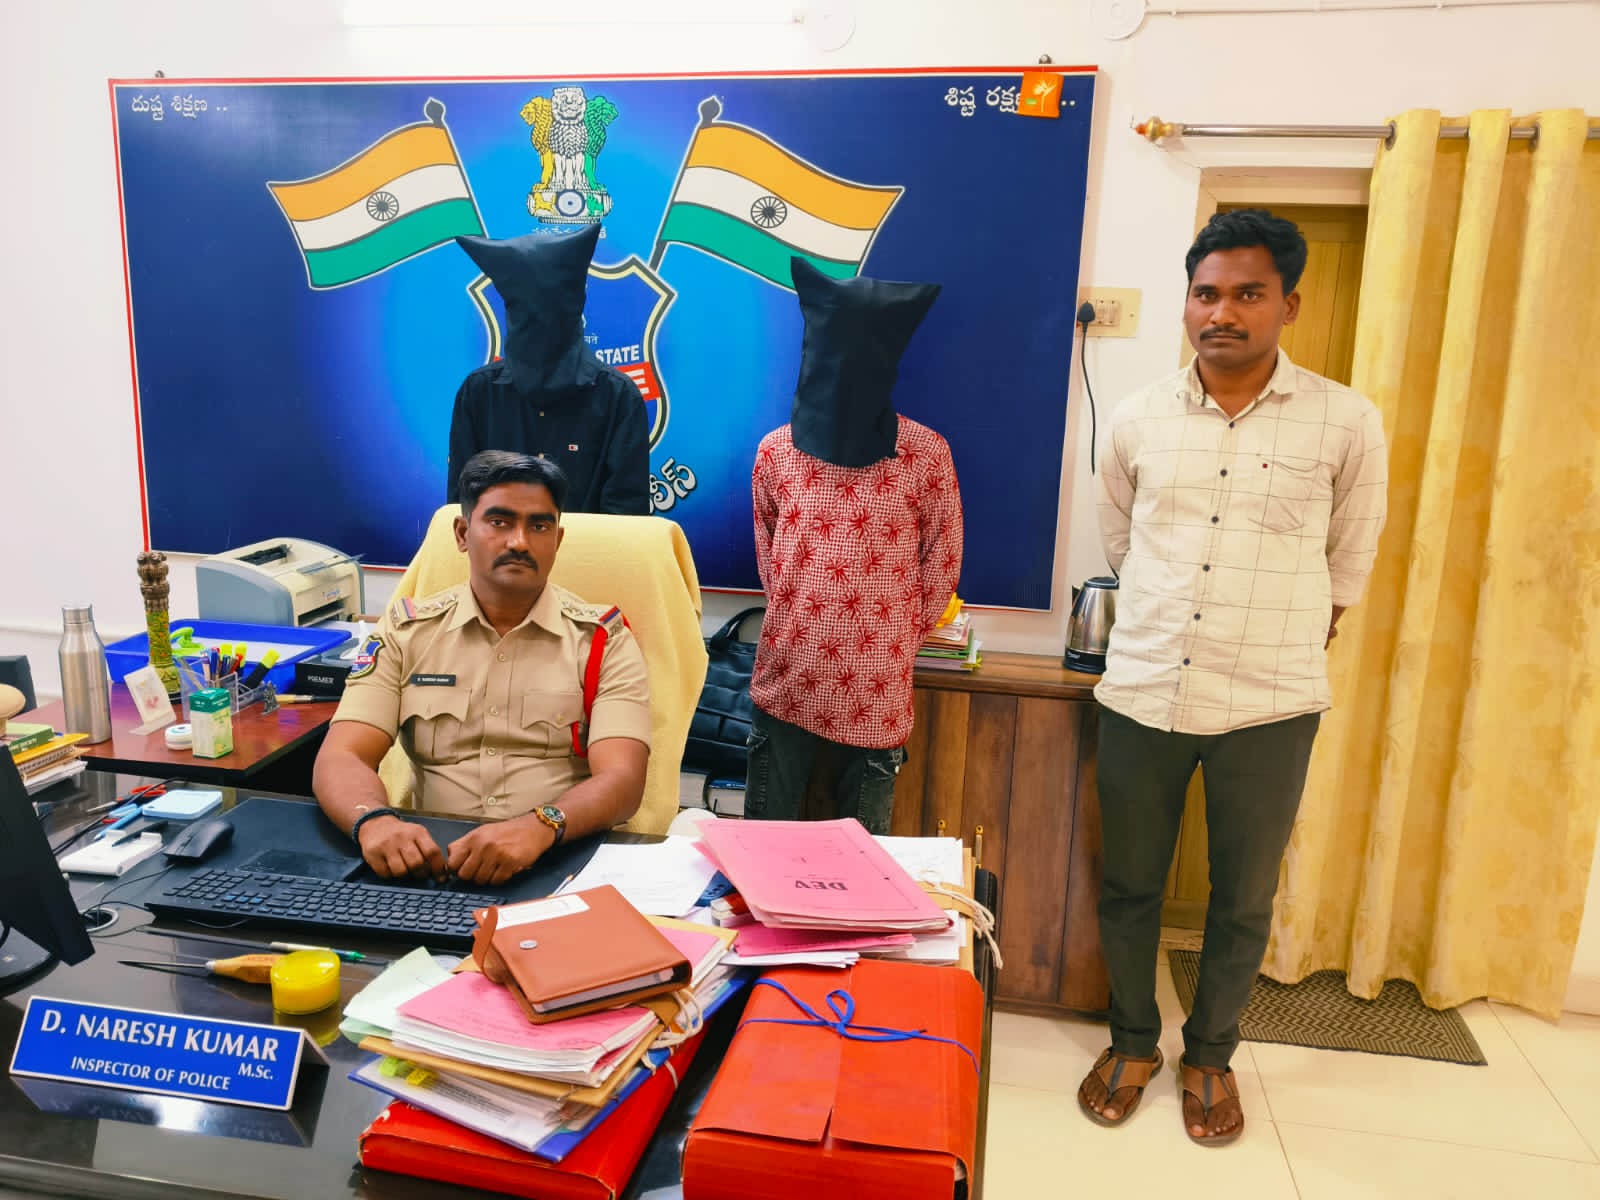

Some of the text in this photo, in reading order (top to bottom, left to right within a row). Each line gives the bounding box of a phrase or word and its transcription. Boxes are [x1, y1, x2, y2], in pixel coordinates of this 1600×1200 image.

[985, 86, 1021, 114] రక్ష
[595, 344, 640, 366] STATE
[795, 879, 849, 891] DEV
[41, 1009, 279, 1062] D. NARESH KUMAR
[71, 1056, 231, 1091] INSPECTOR OF POLICE
[238, 1062, 273, 1080] M.Sc.
